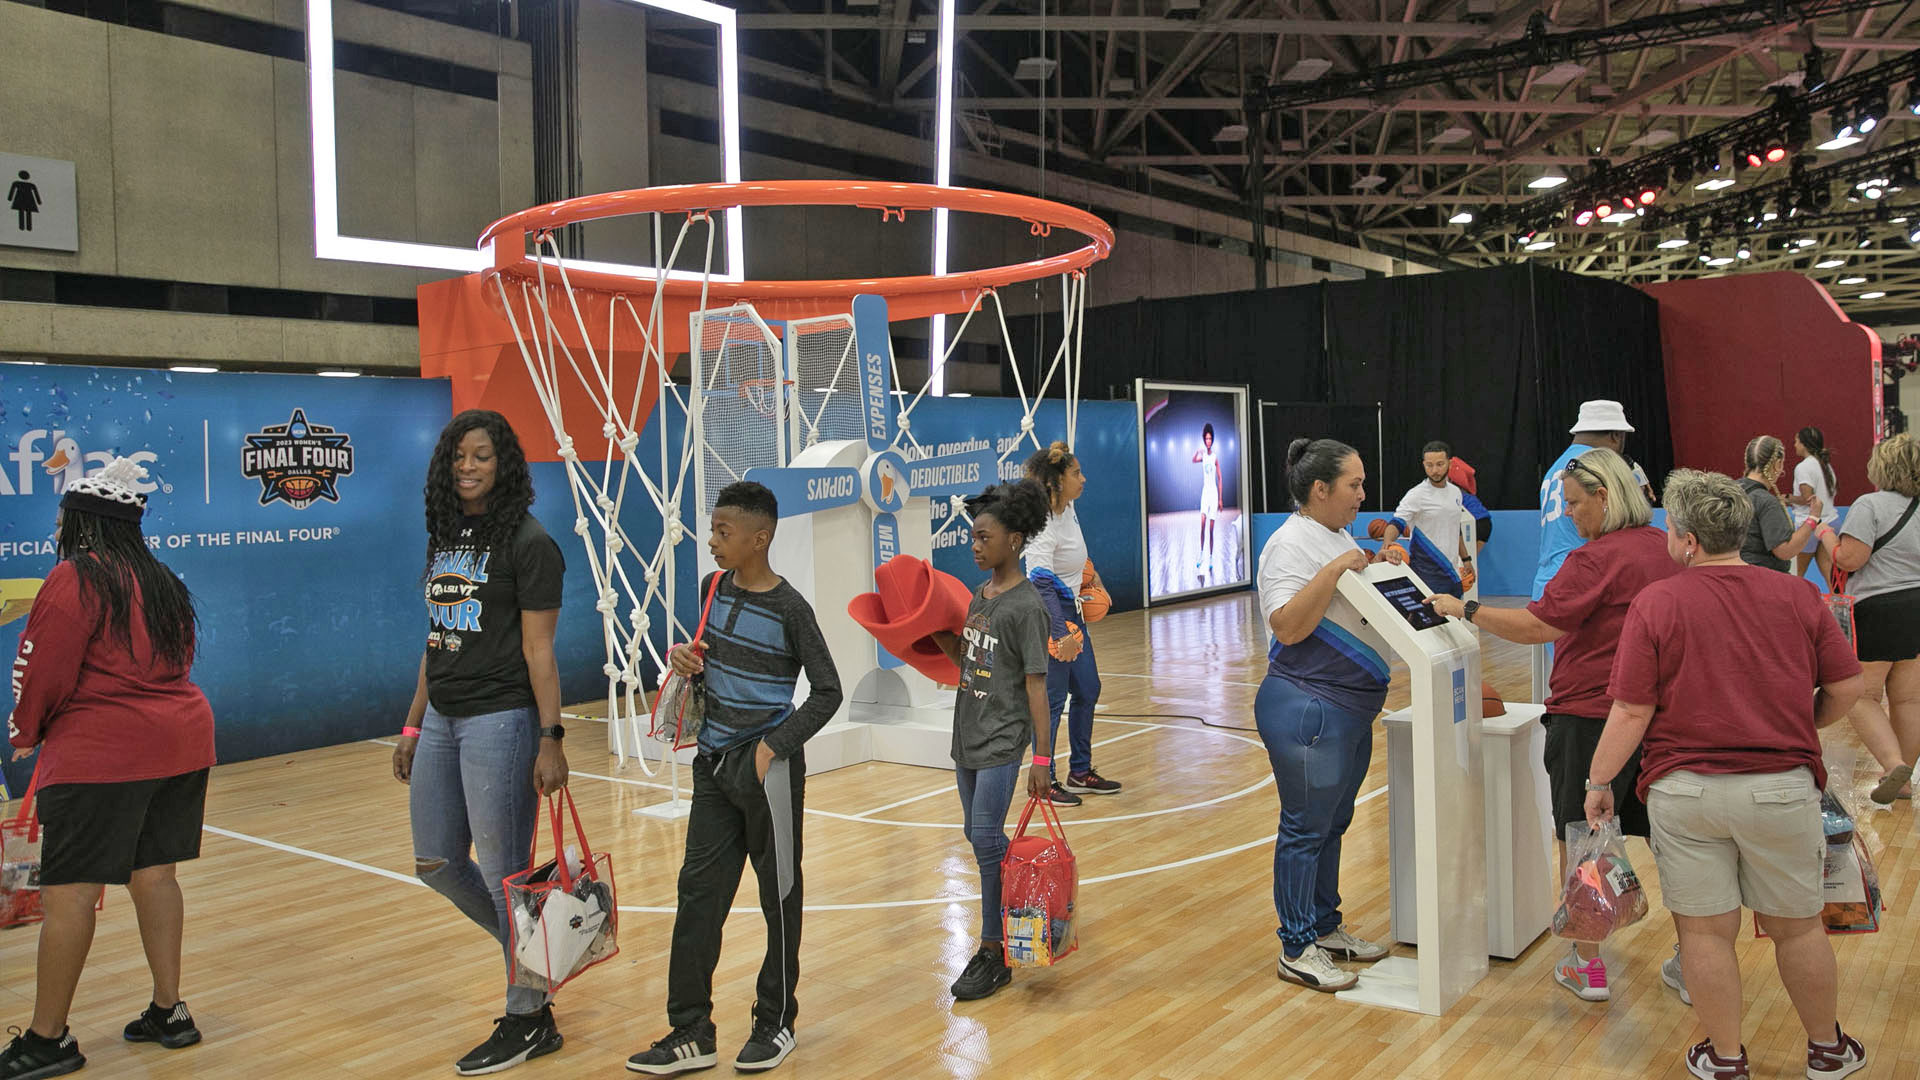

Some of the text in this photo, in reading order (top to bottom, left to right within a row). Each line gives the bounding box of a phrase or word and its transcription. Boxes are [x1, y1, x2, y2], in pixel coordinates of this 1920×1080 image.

[866, 353, 888, 441] EXPENSES
[246, 447, 349, 472] FINAL FOUR
[807, 474, 854, 500] COPAYS
[910, 462, 980, 490] DEDUCTIBLES
[0, 541, 60, 557] FICIA
[166, 534, 191, 549] OF
[197, 533, 231, 547] THE
[236, 531, 284, 545] FINAL
[428, 551, 490, 583] INAL
[443, 585, 458, 593] LSU
